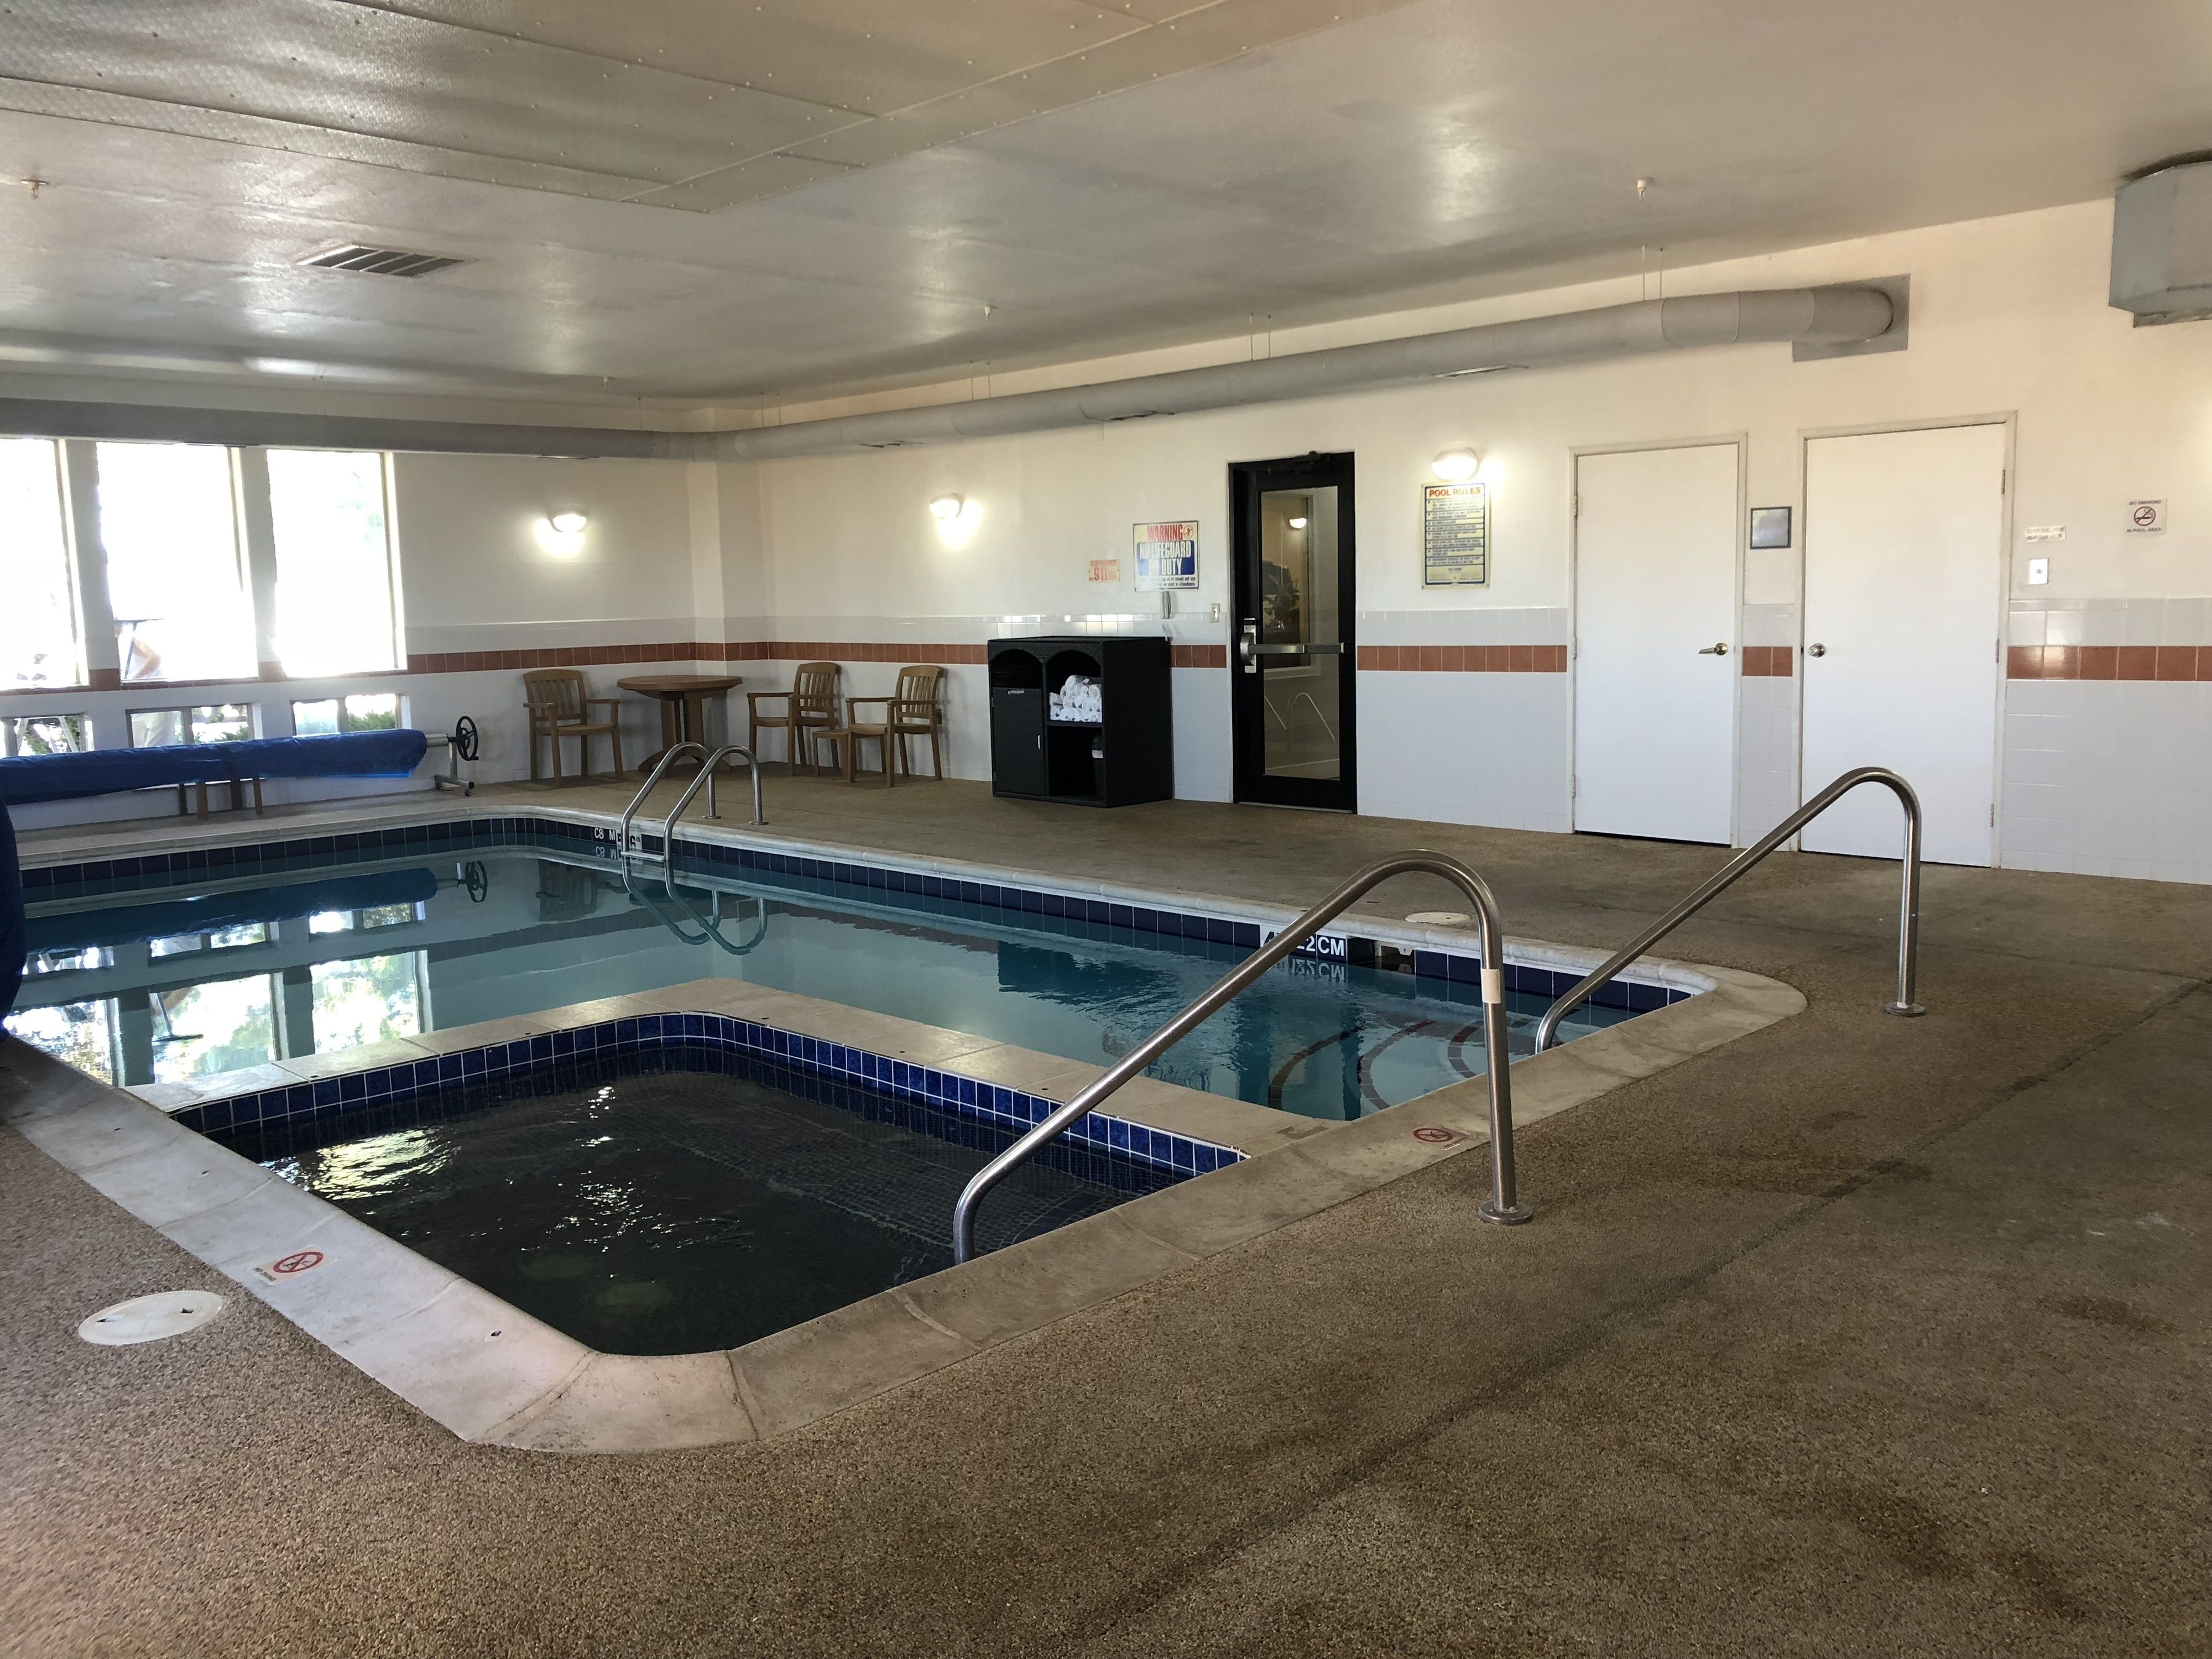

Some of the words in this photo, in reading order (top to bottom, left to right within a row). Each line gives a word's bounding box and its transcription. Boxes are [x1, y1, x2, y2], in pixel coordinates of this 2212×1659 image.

[1429, 489, 1451, 497] POOL
[1453, 487, 1481, 495] RULES
[1147, 524, 1183, 541] WARNING
[1151, 540, 1191, 559] LIFEGUARD
[1094, 567, 1108, 581] 911
[1161, 557, 1182, 575] DUTY
